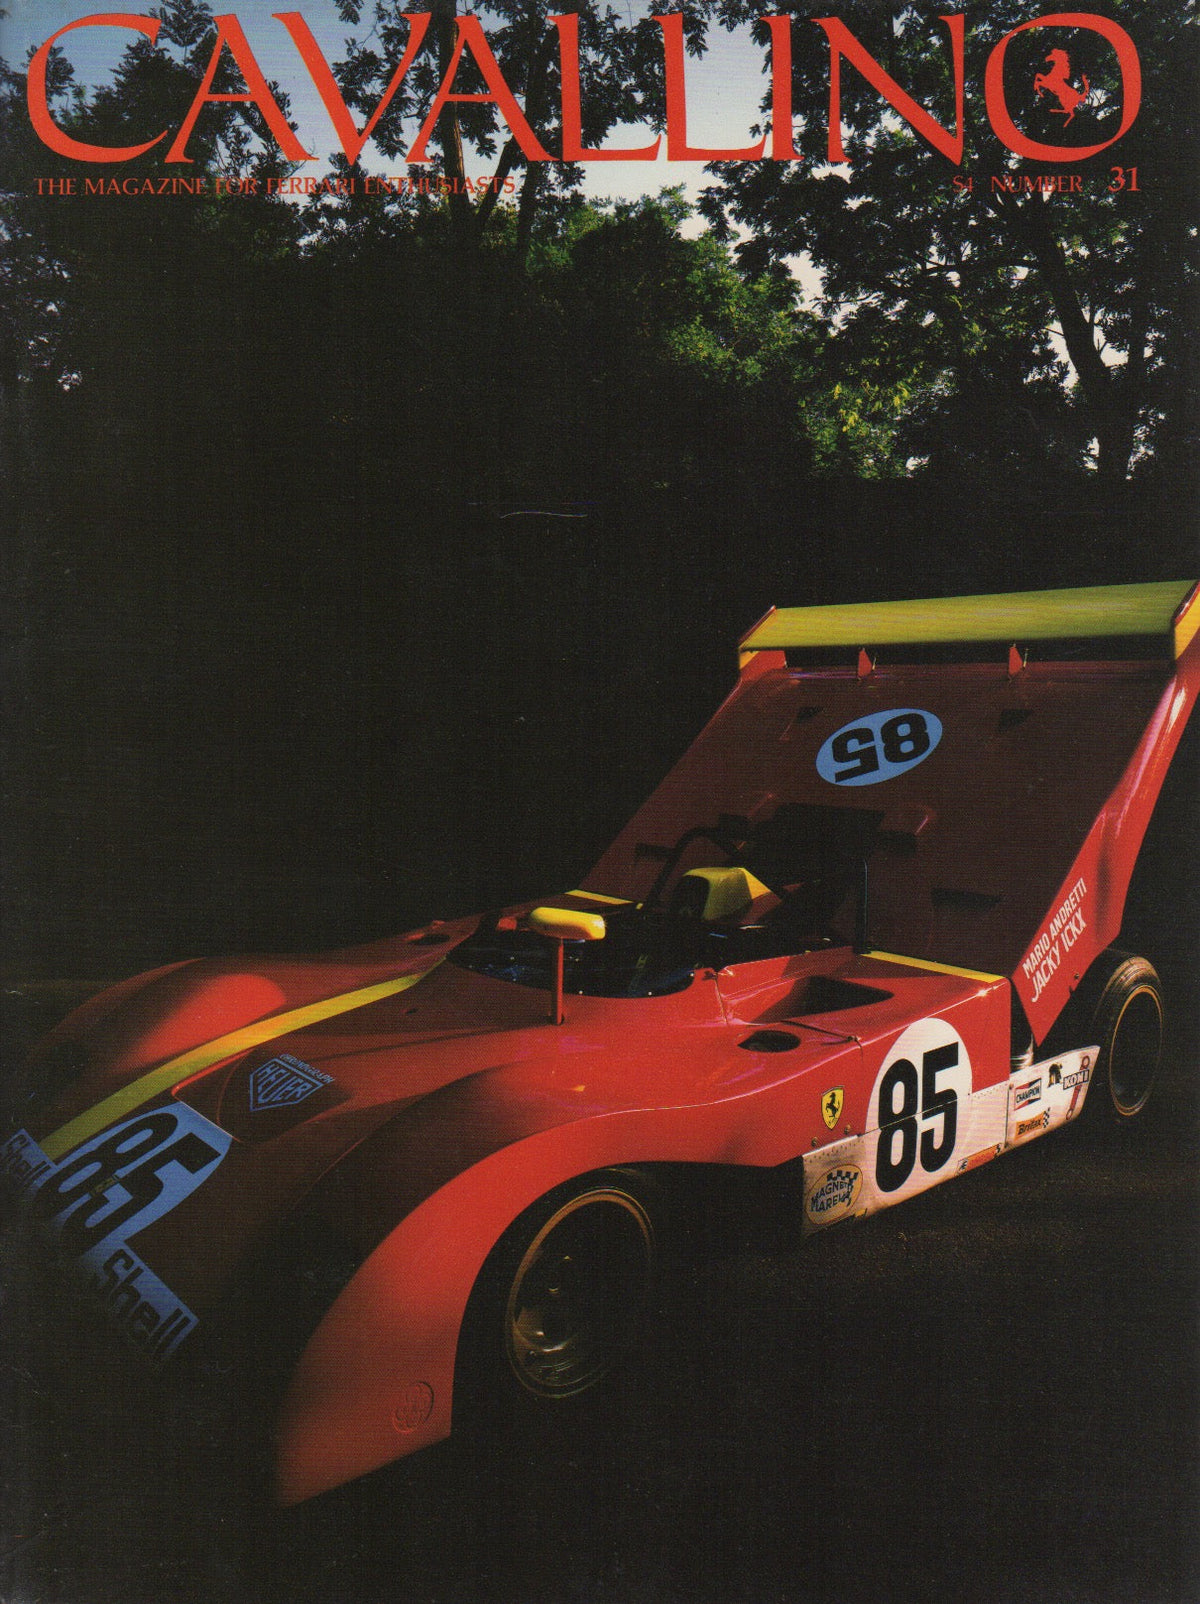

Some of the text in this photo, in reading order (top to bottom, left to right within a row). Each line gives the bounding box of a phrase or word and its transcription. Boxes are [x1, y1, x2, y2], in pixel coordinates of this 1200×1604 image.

[832, 713, 930, 782] 85
[1022, 877, 1087, 979] MARIO ANDRETTI
[1031, 907, 1087, 1003] JACKY ICKX
[257, 1063, 313, 1104] HEUER
[875, 1042, 959, 1193] 85
[1015, 1086, 1040, 1103] CHAMPION
[1063, 1069, 1089, 1089] KONI
[1018, 1118, 1042, 1135] Britax
[36, 1112, 222, 1253] 85
[103, 1248, 192, 1355] Shell
